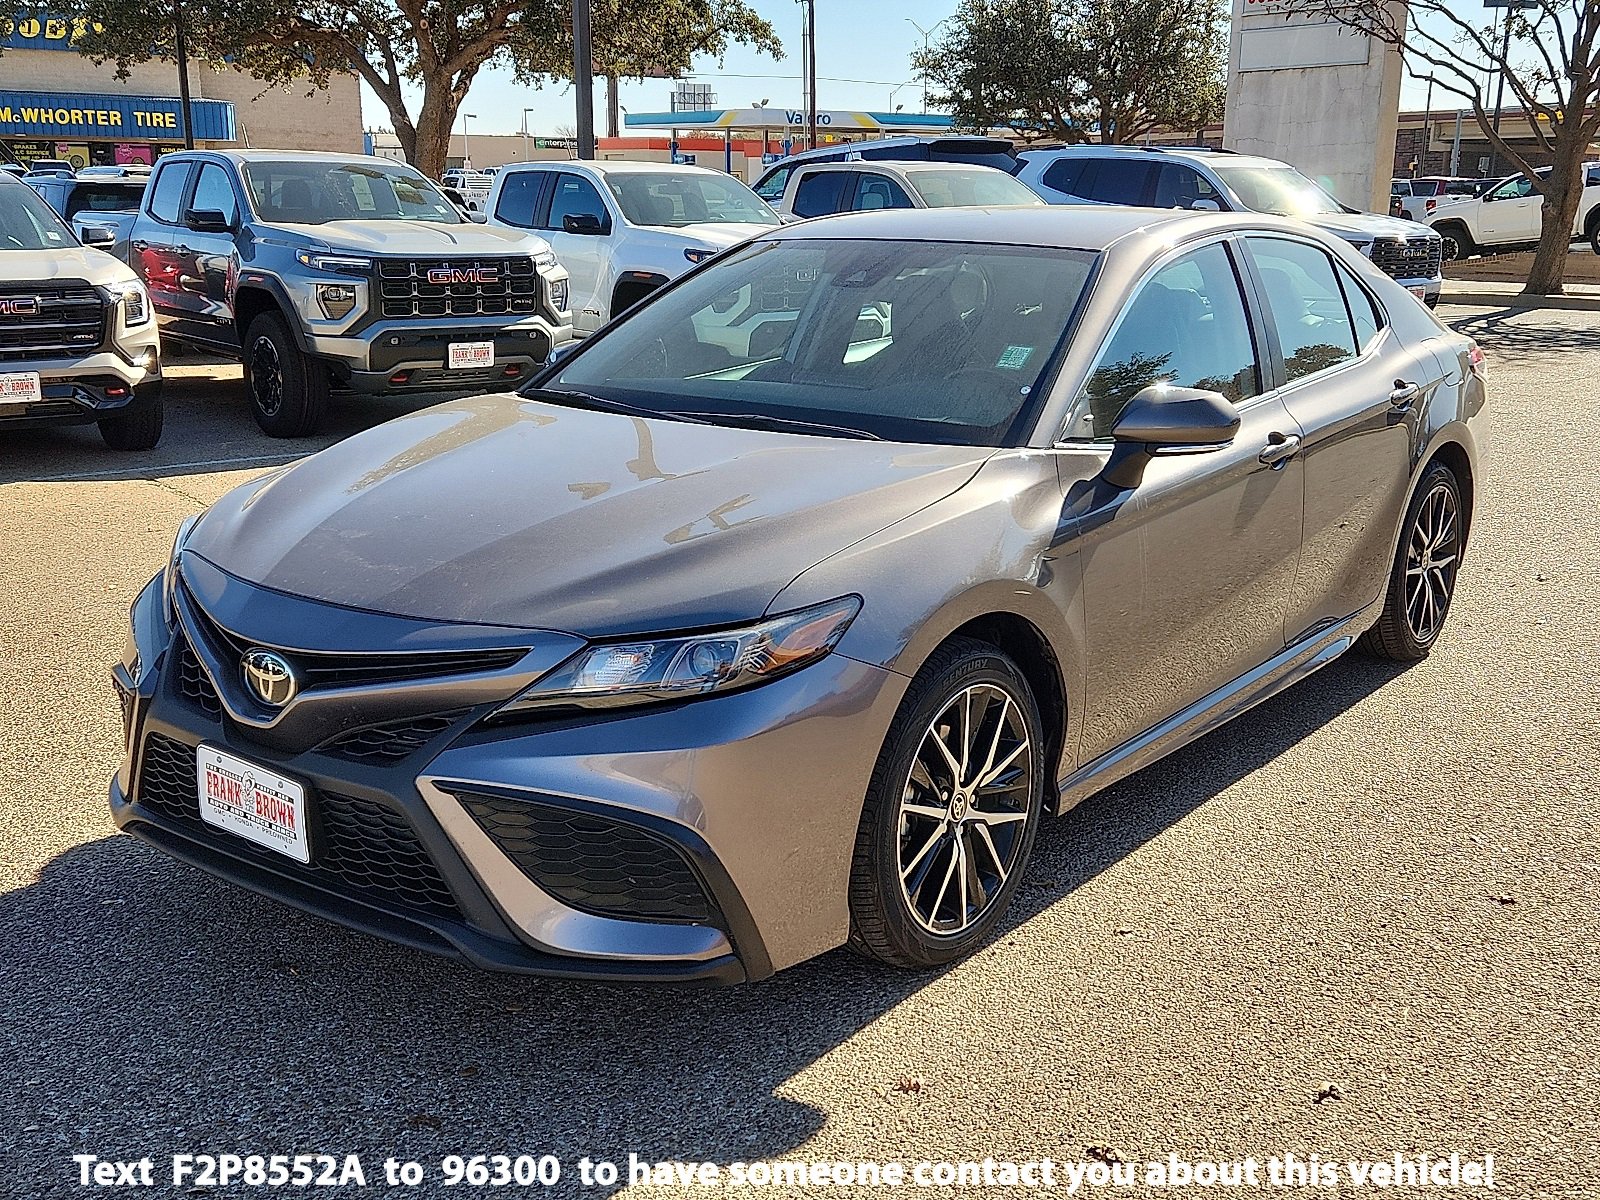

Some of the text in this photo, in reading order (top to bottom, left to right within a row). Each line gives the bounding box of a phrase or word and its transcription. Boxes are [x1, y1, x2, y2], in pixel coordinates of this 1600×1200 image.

[0, 107, 177, 128] McWHORTER TIRE
[785, 111, 832, 125] Varo
[427, 268, 499, 284] GMC
[11, 381, 35, 391] BROWN
[206, 771, 296, 831] FRANK BROWN
